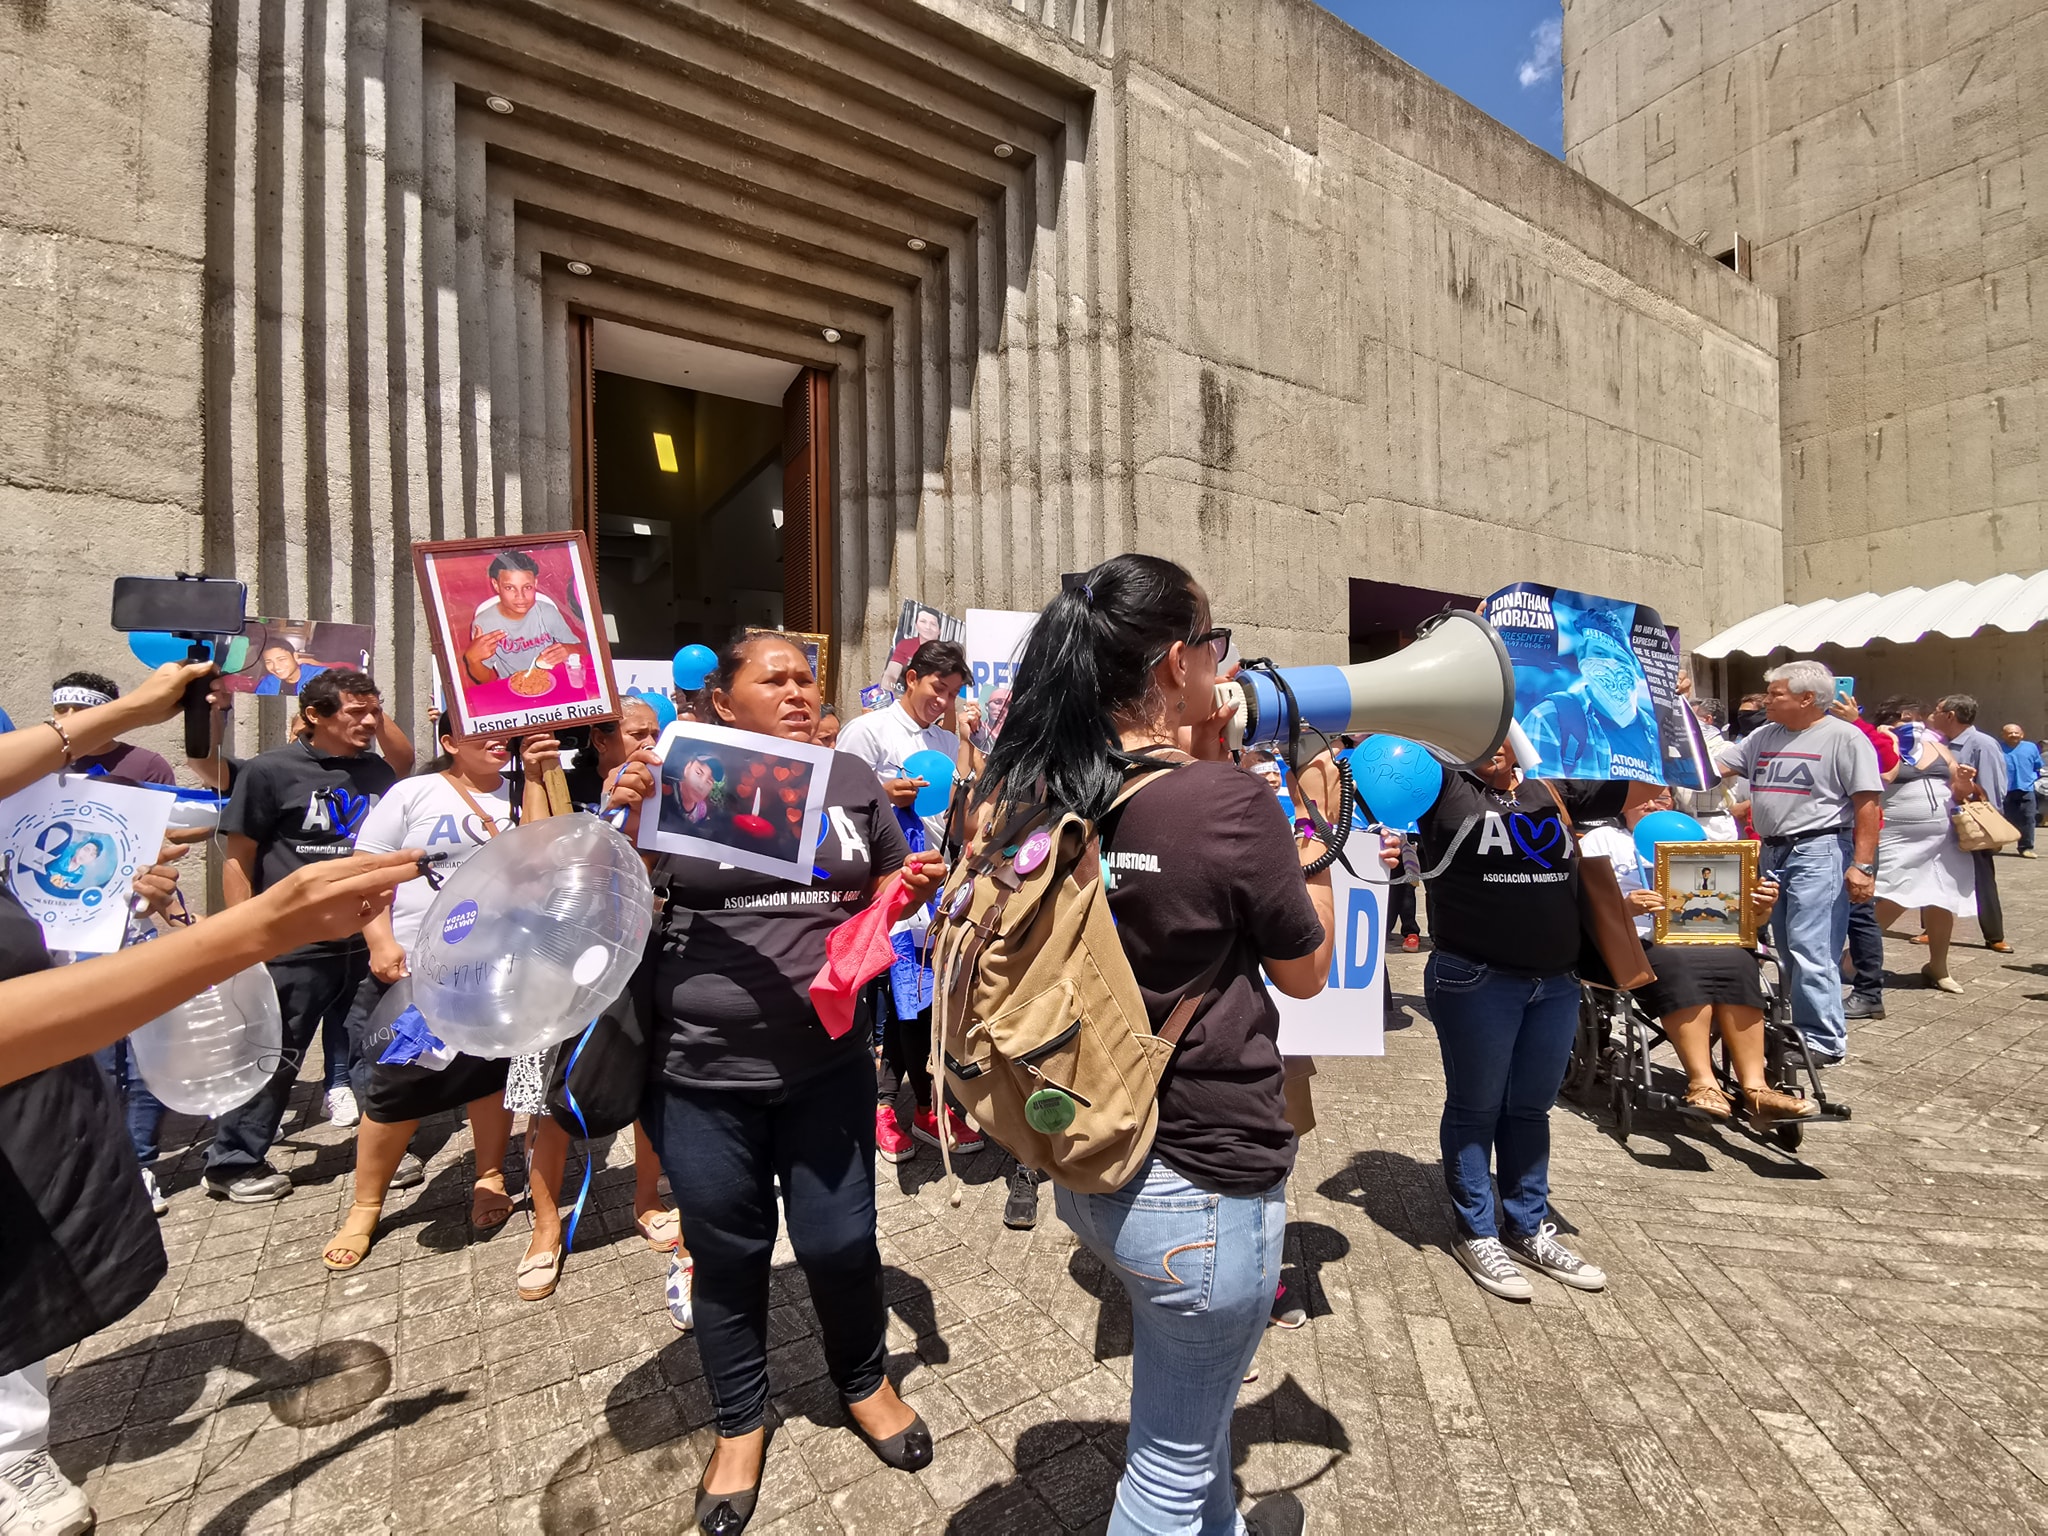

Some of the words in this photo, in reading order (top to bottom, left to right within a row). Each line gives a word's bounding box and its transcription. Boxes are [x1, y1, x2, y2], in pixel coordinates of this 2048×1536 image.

[1490, 592, 1551, 614] JONATHAN
[1490, 609, 1555, 630] MORAZAN
[1643, 625, 1654, 634] HAY
[1632, 635, 1659, 648] EXPRESAR
[1661, 640, 1669, 650] LO
[472, 717, 518, 734] Jesner
[523, 707, 563, 726] Josué
[566, 704, 605, 720] Rivas
[1753, 760, 1815, 786] FILA
[295, 845, 337, 855] ASOCIACIÓN
[1115, 852, 1162, 873] JUSTICIA.
[1482, 872, 1532, 884] ASOCIACIÓN
[1532, 872, 1558, 884] MADRES
[724, 890, 788, 909] ASOCIACIÓN
[790, 890, 830, 905] MADRES
[446, 910, 477, 925] OLVIDA
